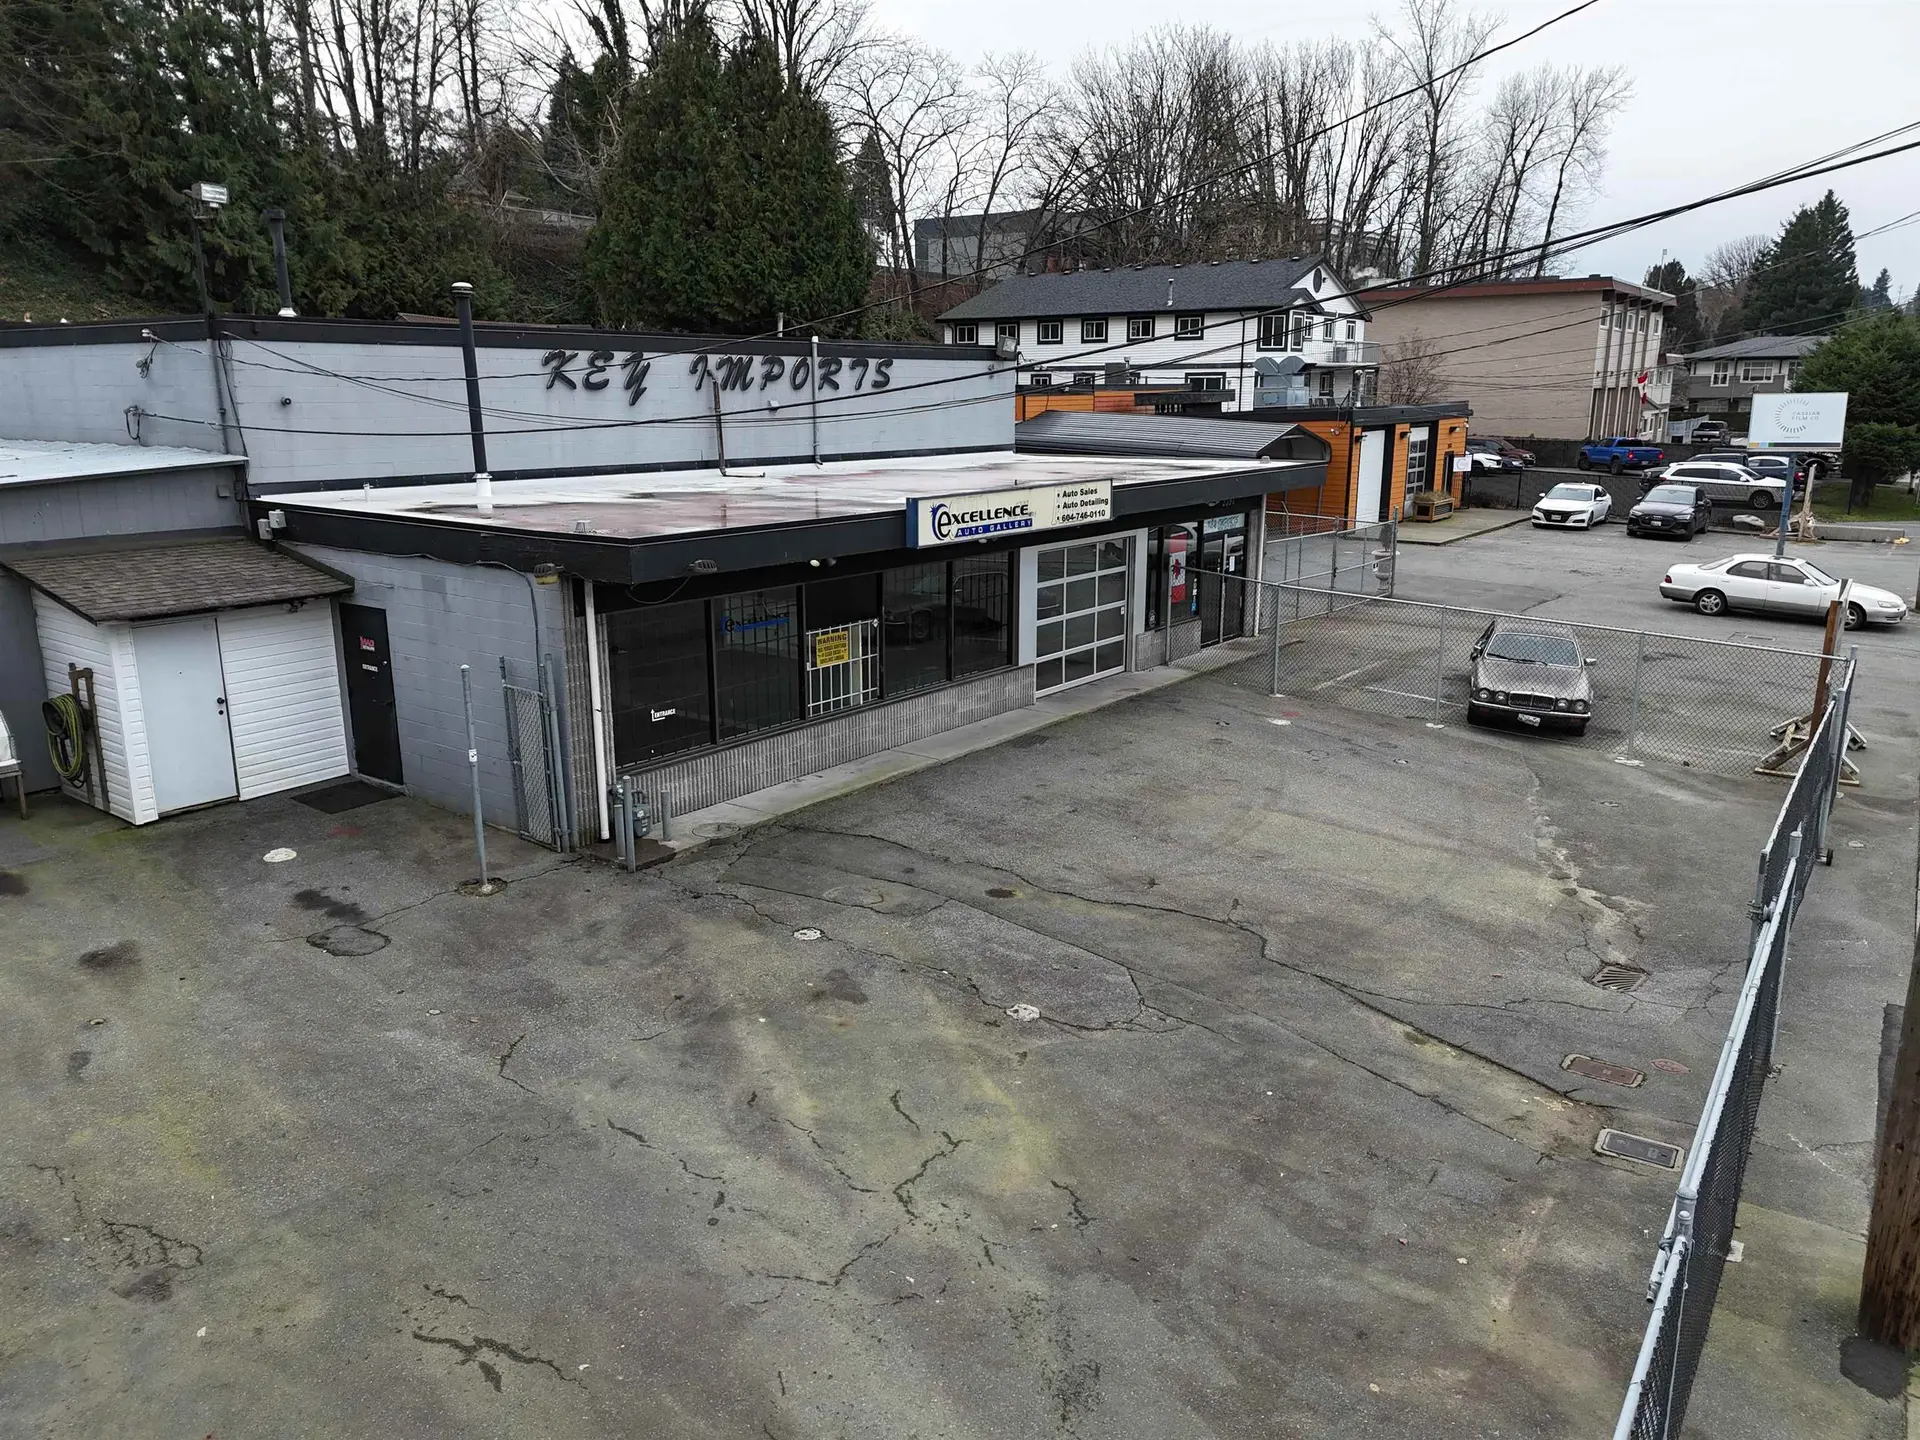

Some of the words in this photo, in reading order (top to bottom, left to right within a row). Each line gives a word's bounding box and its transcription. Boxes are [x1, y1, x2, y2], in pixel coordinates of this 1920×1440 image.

[540, 348, 650, 406] KEY
[688, 353, 894, 392] IMPORTS
[1062, 489, 1079, 498] Auto
[1080, 487, 1098, 496] Sales
[1062, 500, 1079, 509] Auto
[1080, 498, 1109, 508] Detailing
[1061, 509, 1106, 522] 604-746-0110
[957, 527, 984, 537] AUTO
[989, 520, 1032, 532] GALLERY
[818, 634, 847, 646] WARNING
[654, 708, 676, 718] ENTRANCE
